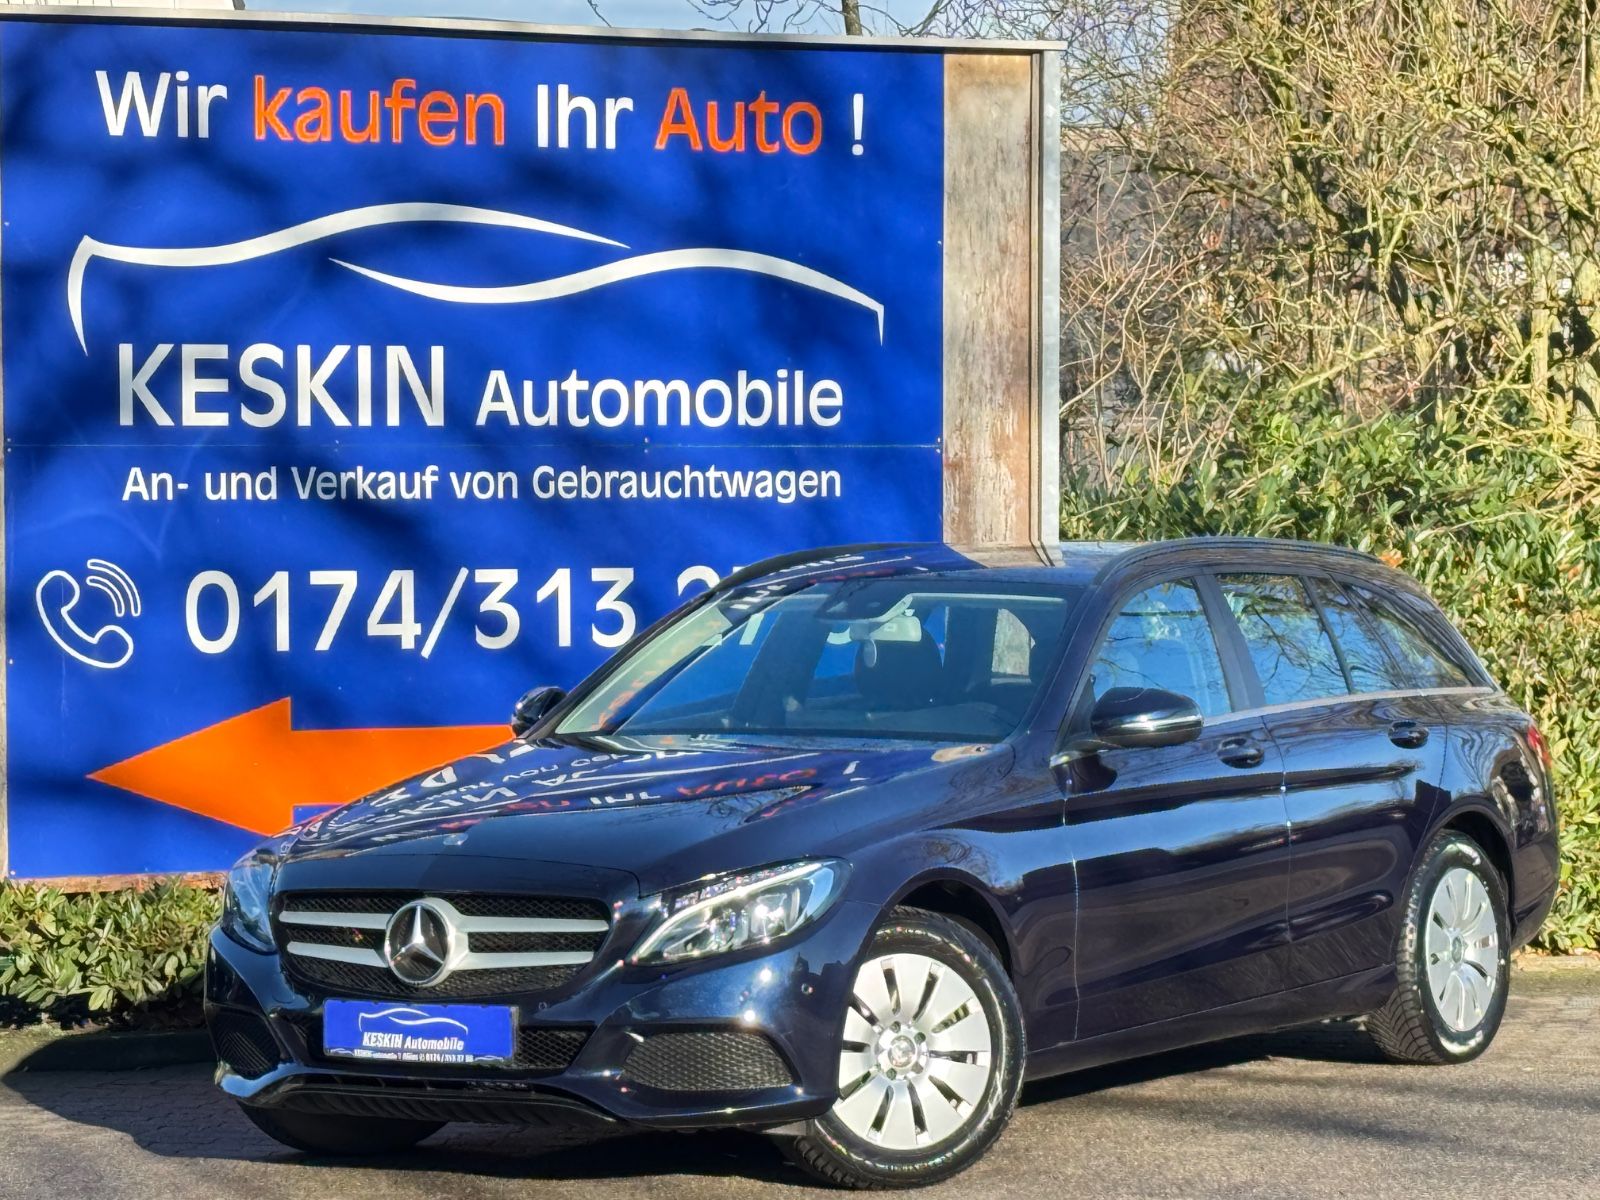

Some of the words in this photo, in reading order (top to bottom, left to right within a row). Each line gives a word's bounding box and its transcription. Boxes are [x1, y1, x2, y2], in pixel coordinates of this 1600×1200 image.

[95, 70, 228, 139] Wir
[252, 74, 506, 148] kaufen
[536, 83, 634, 151] Ihr
[653, 86, 823, 157] Auto
[851, 93, 864, 156] !
[118, 342, 445, 428] KESKIN
[475, 367, 844, 429] Automobile
[121, 466, 190, 502] An-
[204, 466, 278, 501] und
[291, 464, 440, 501] Verkauf
[449, 470, 519, 500] von
[532, 463, 841, 504] Gebrauchtwagen
[185, 566, 637, 660] 0174/313
[362, 1031, 404, 1048] KESKIN
[404, 1036, 465, 1051] Automobile
